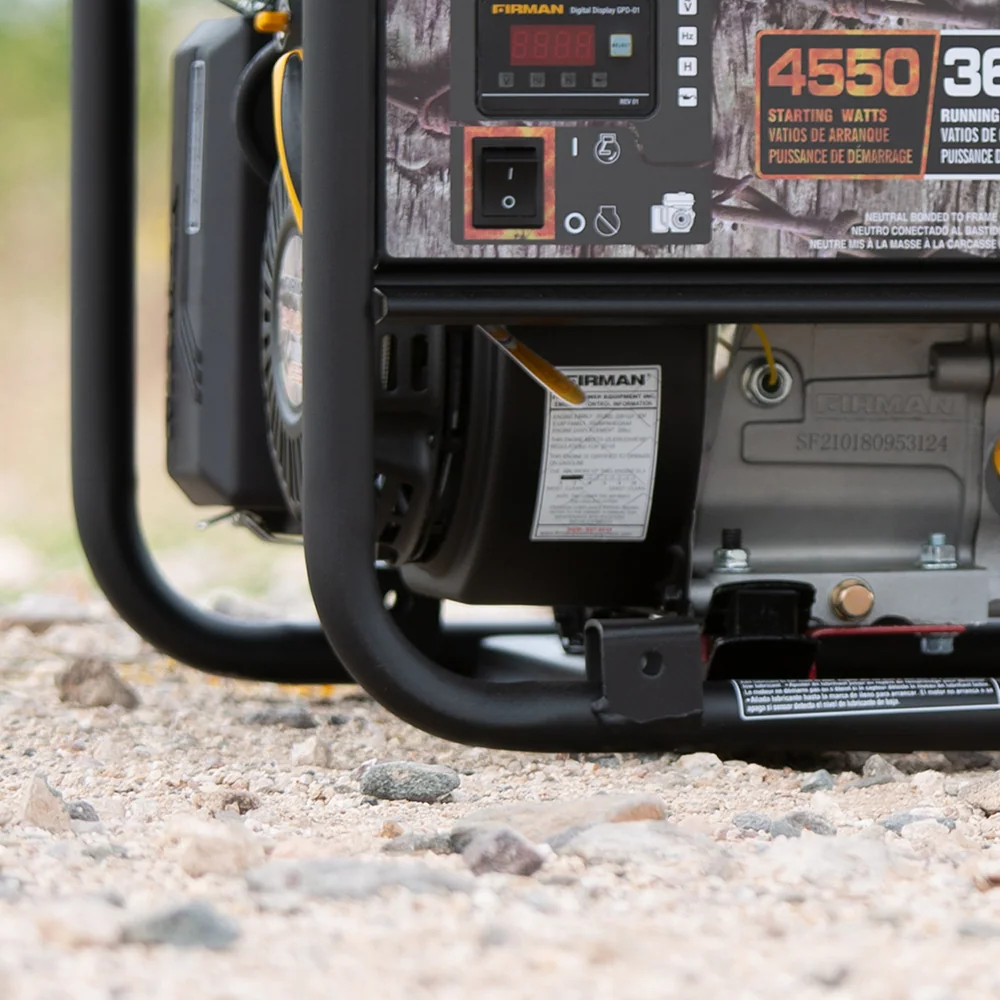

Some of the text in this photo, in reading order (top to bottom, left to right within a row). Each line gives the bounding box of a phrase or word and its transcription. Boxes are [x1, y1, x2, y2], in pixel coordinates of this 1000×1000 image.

[492, 4, 565, 14] FIRMAN
[569, 6, 592, 16] Digital
[592, 6, 616, 16] Display
[682, 32, 694, 40] Hz
[684, 62, 692, 71] H
[768, 47, 921, 97] 4550
[768, 108, 888, 123] STARTING WATTS
[940, 108, 1000, 123] RUNNING
[768, 127, 890, 144] VATIOS DE ARRANQUE
[940, 127, 980, 143] VATIOS
[981, 127, 997, 143] DE
[768, 144, 913, 164] PUISSANCE DE DÉMARRAGE
[940, 148, 993, 164] PUISSANCE
[865, 212, 998, 222] NEUTRAL BONDED TO FRAME
[851, 225, 889, 236] NEUTRO
[891, 225, 949, 236] CONECTADO
[951, 225, 963, 236] AL
[809, 239, 848, 249] NEUTRE
[849, 239, 865, 249] MIS
[867, 237, 874, 249] À
[876, 239, 888, 249] LA
[890, 239, 922, 249] MASSE
[924, 237, 931, 249] À
[932, 239, 945, 249] LA
[947, 239, 998, 249] CARCASSE
[567, 374, 646, 386] IRMAN
[816, 392, 955, 415] FIRMAN
